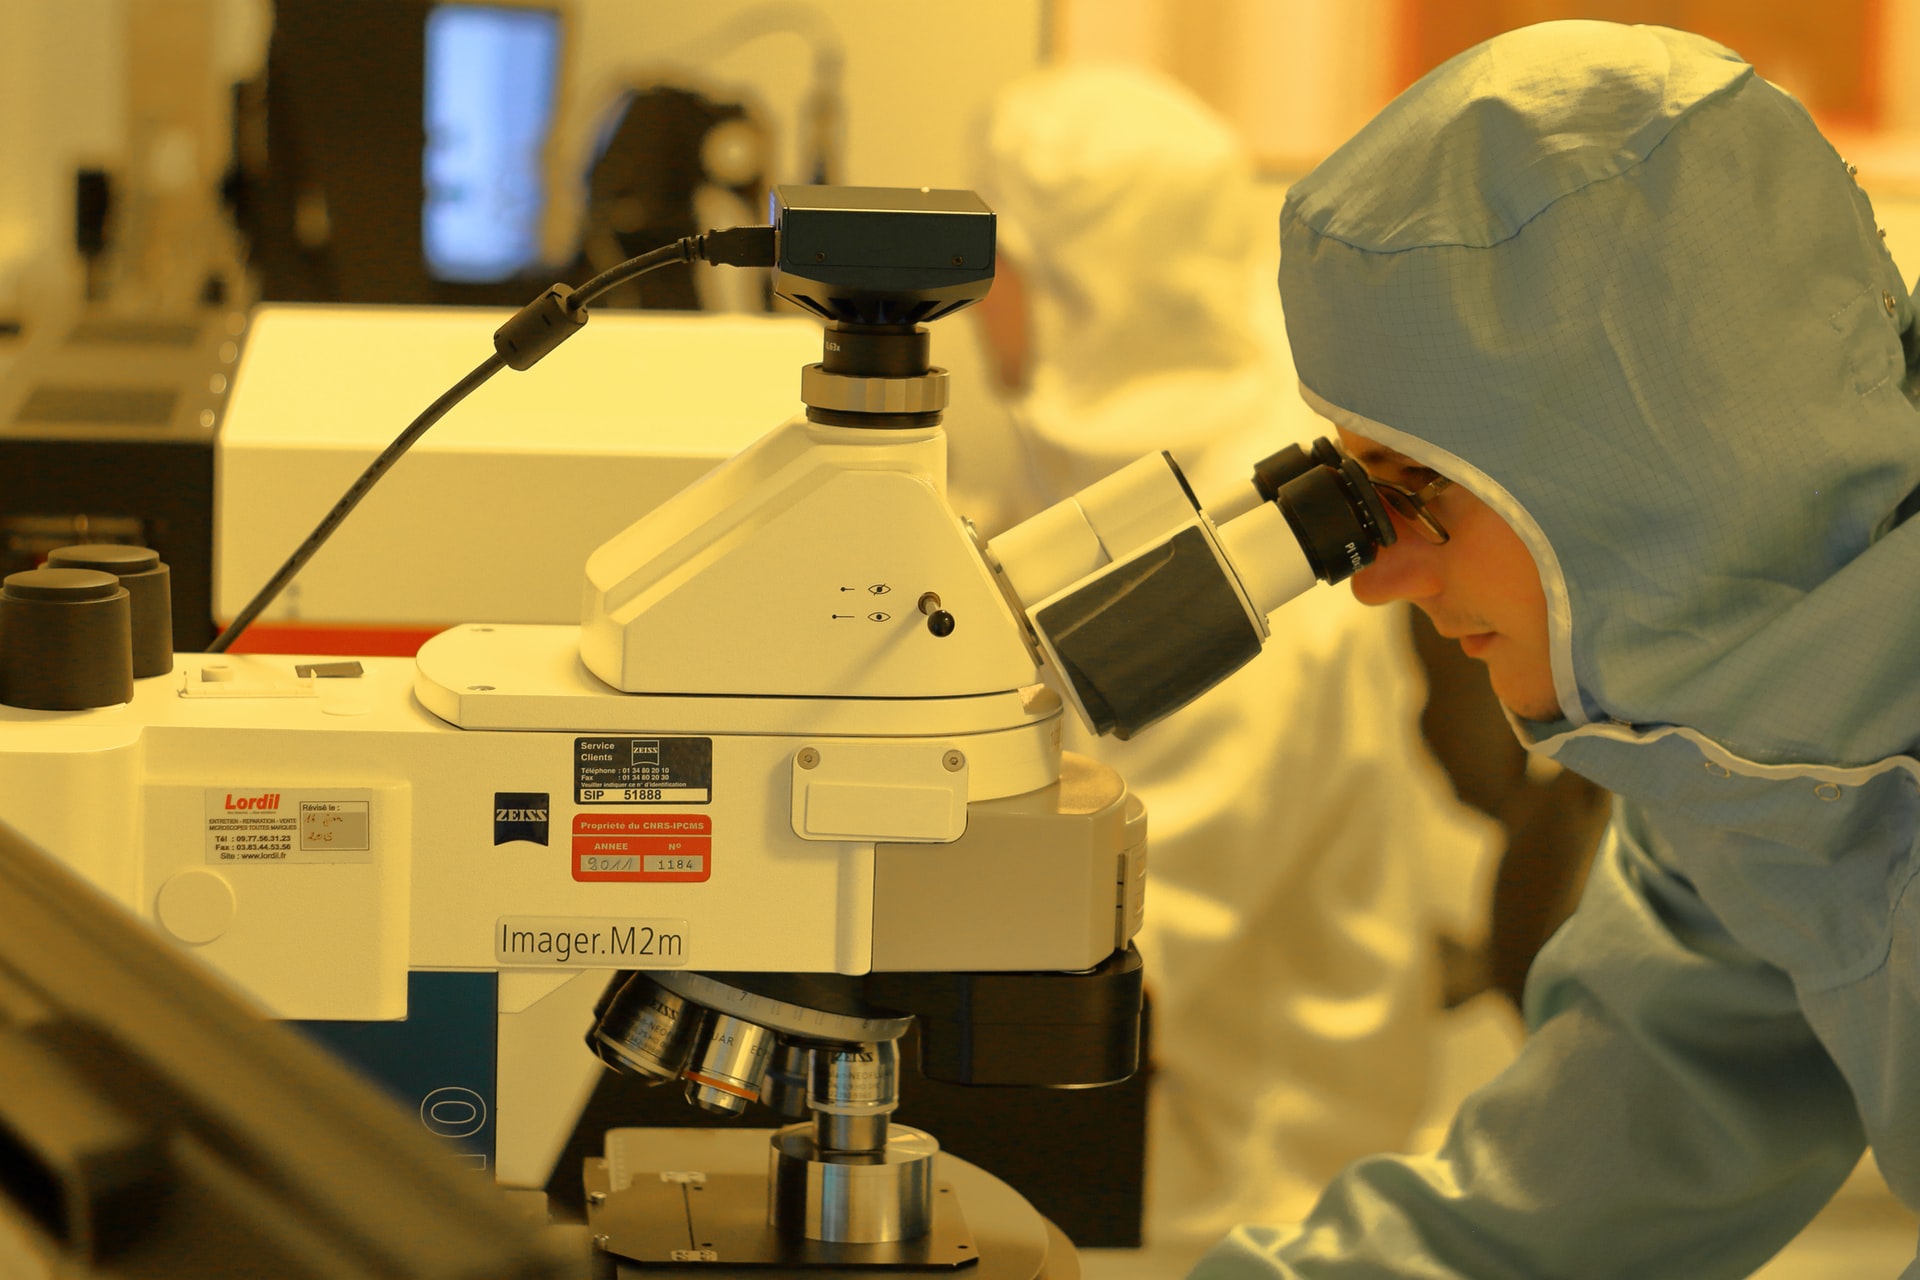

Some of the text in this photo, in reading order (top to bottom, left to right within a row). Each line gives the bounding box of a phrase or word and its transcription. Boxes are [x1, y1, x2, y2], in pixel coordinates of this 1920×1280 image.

[581, 742, 615, 750] Service
[584, 790, 662, 800] SIP 51888
[225, 793, 280, 810] Lordil
[495, 809, 548, 822] ZEISS
[220, 852, 235, 860] Site
[241, 852, 286, 860] www.lordil.fr
[658, 860, 693, 869] 1184
[502, 924, 682, 962] Imager.M2m
